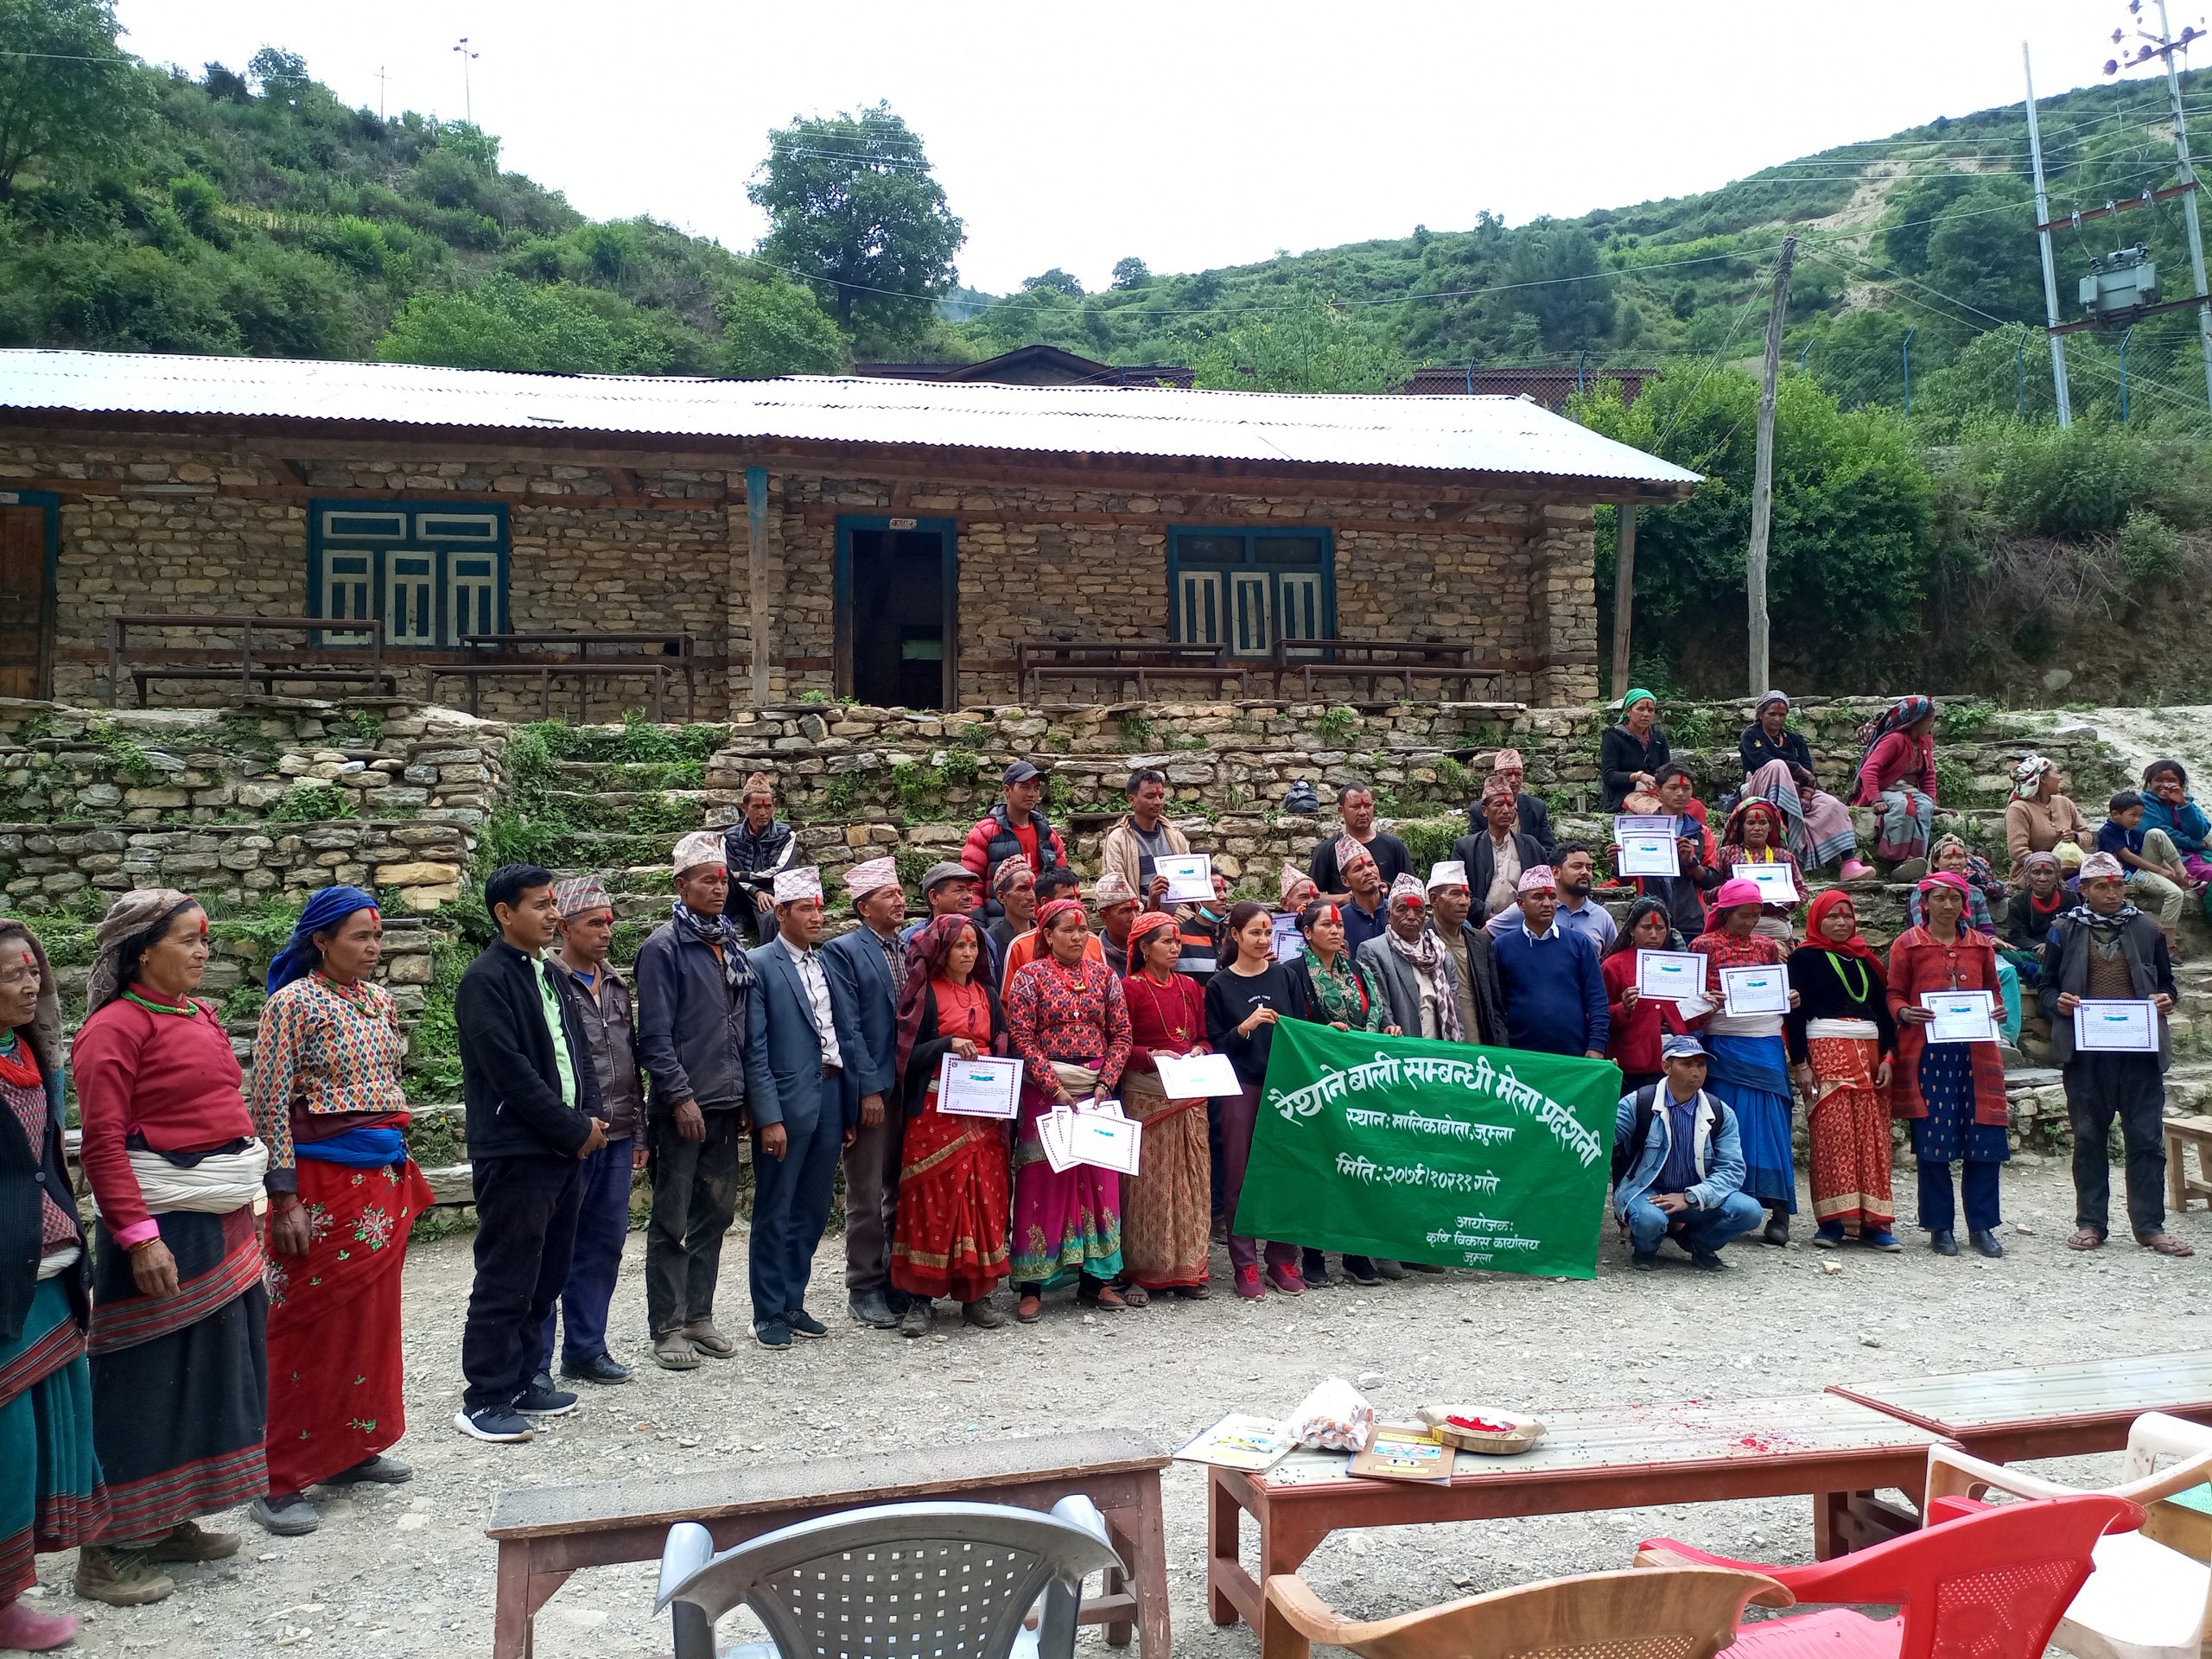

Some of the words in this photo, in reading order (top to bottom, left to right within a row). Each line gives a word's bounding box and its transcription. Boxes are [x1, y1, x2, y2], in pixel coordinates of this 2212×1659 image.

[1348, 1051, 1402, 1094] बाली
[1402, 1055, 1497, 1096] सम्बन्धी
[1495, 1065, 1543, 1116] मेला
[1473, 1169, 1501, 1198] गते
[1426, 1228, 1452, 1248] कृषि
[1453, 1230, 1492, 1250] विकास
[1493, 1234, 1541, 1253] कार्यालय
[1463, 1251, 1494, 1267] जुम्ला
